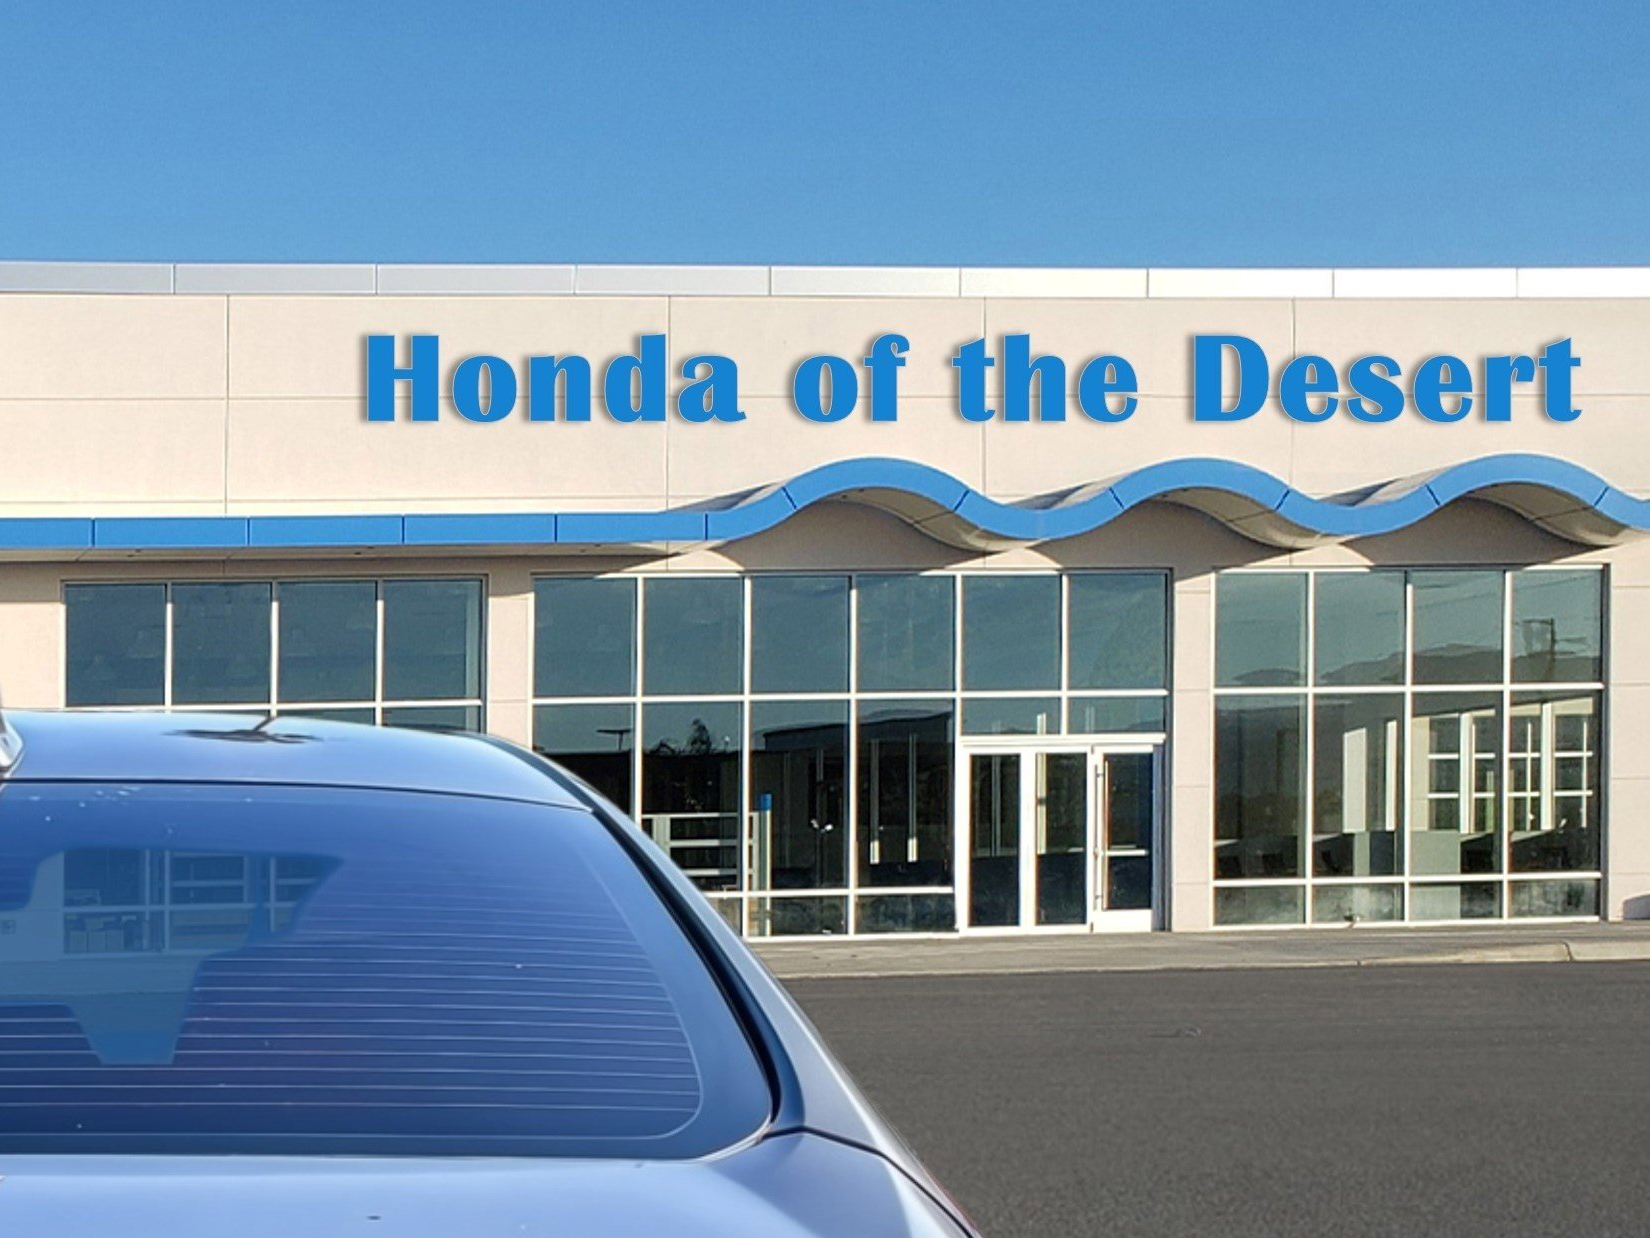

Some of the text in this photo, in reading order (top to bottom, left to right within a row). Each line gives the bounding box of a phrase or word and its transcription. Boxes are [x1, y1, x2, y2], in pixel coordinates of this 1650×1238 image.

[367, 333, 1583, 424] Honda of the Desert
